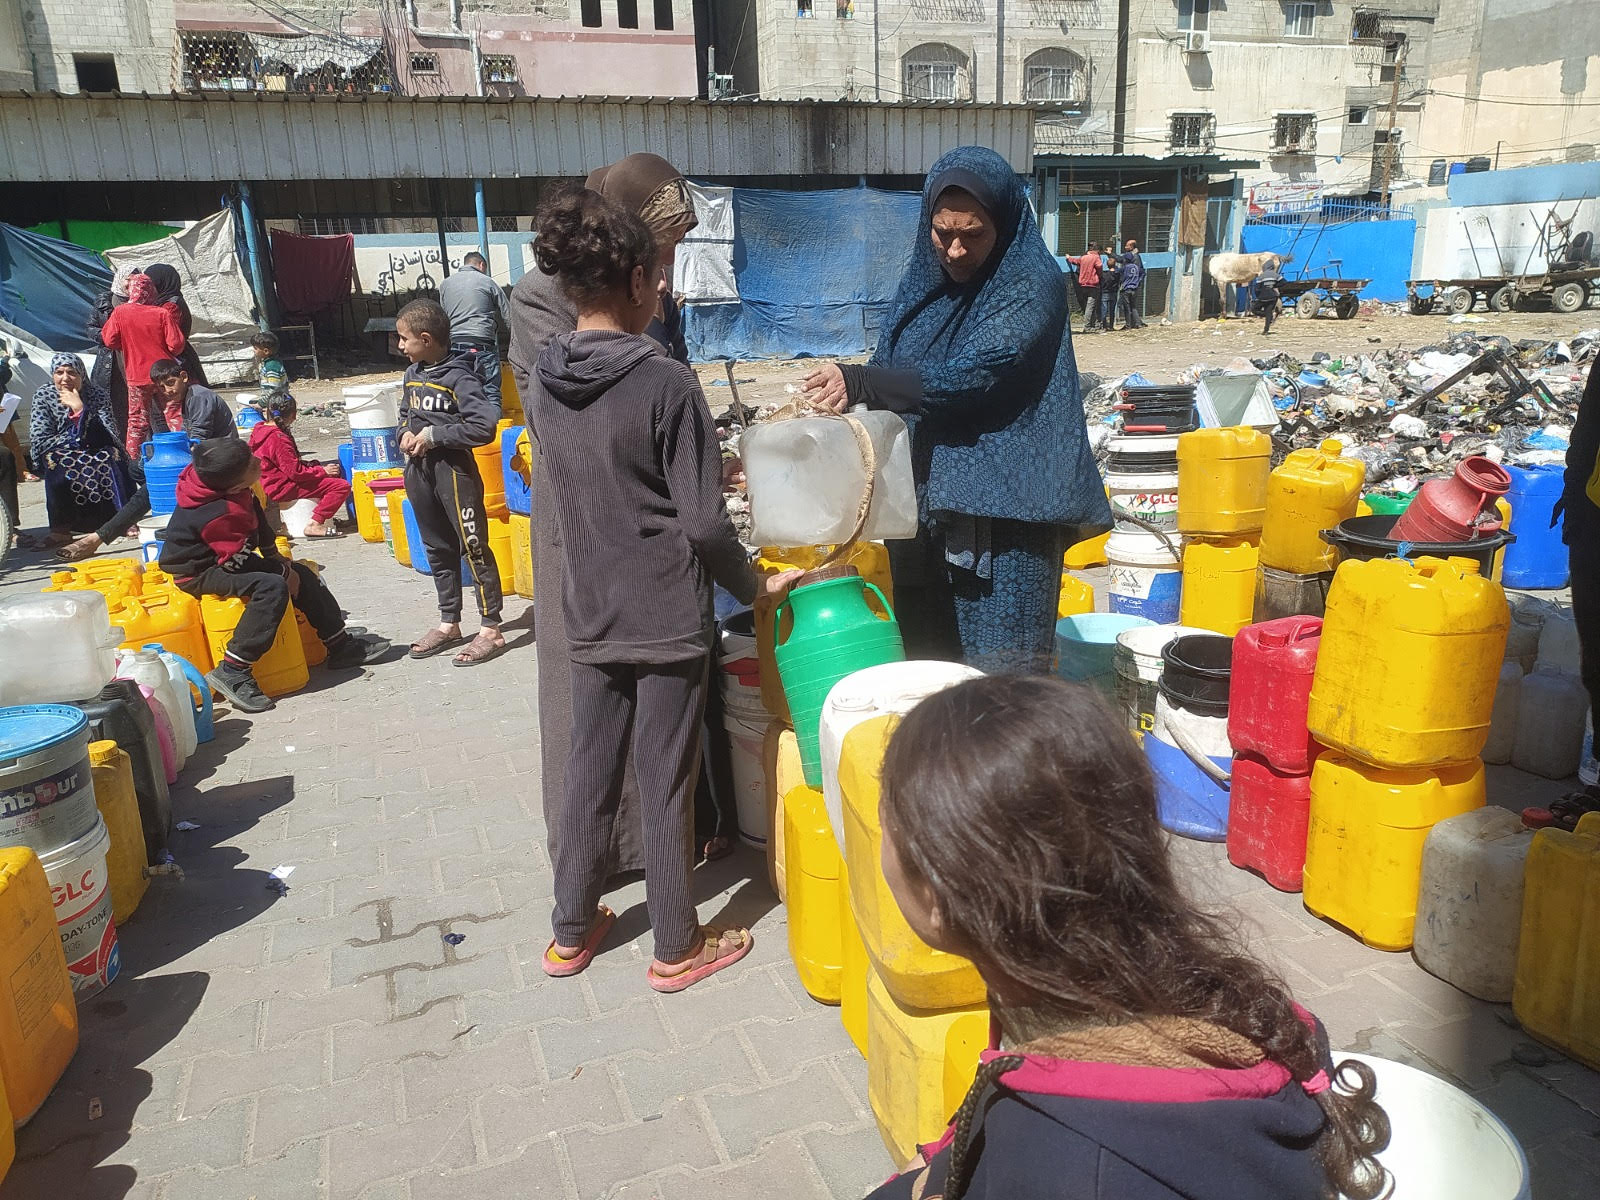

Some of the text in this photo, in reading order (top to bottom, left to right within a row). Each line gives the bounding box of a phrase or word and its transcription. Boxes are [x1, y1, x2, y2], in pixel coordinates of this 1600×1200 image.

[425, 249, 450, 264] لق
[1150, 493, 1177, 505] GLC
[51, 869, 95, 908] GLC
